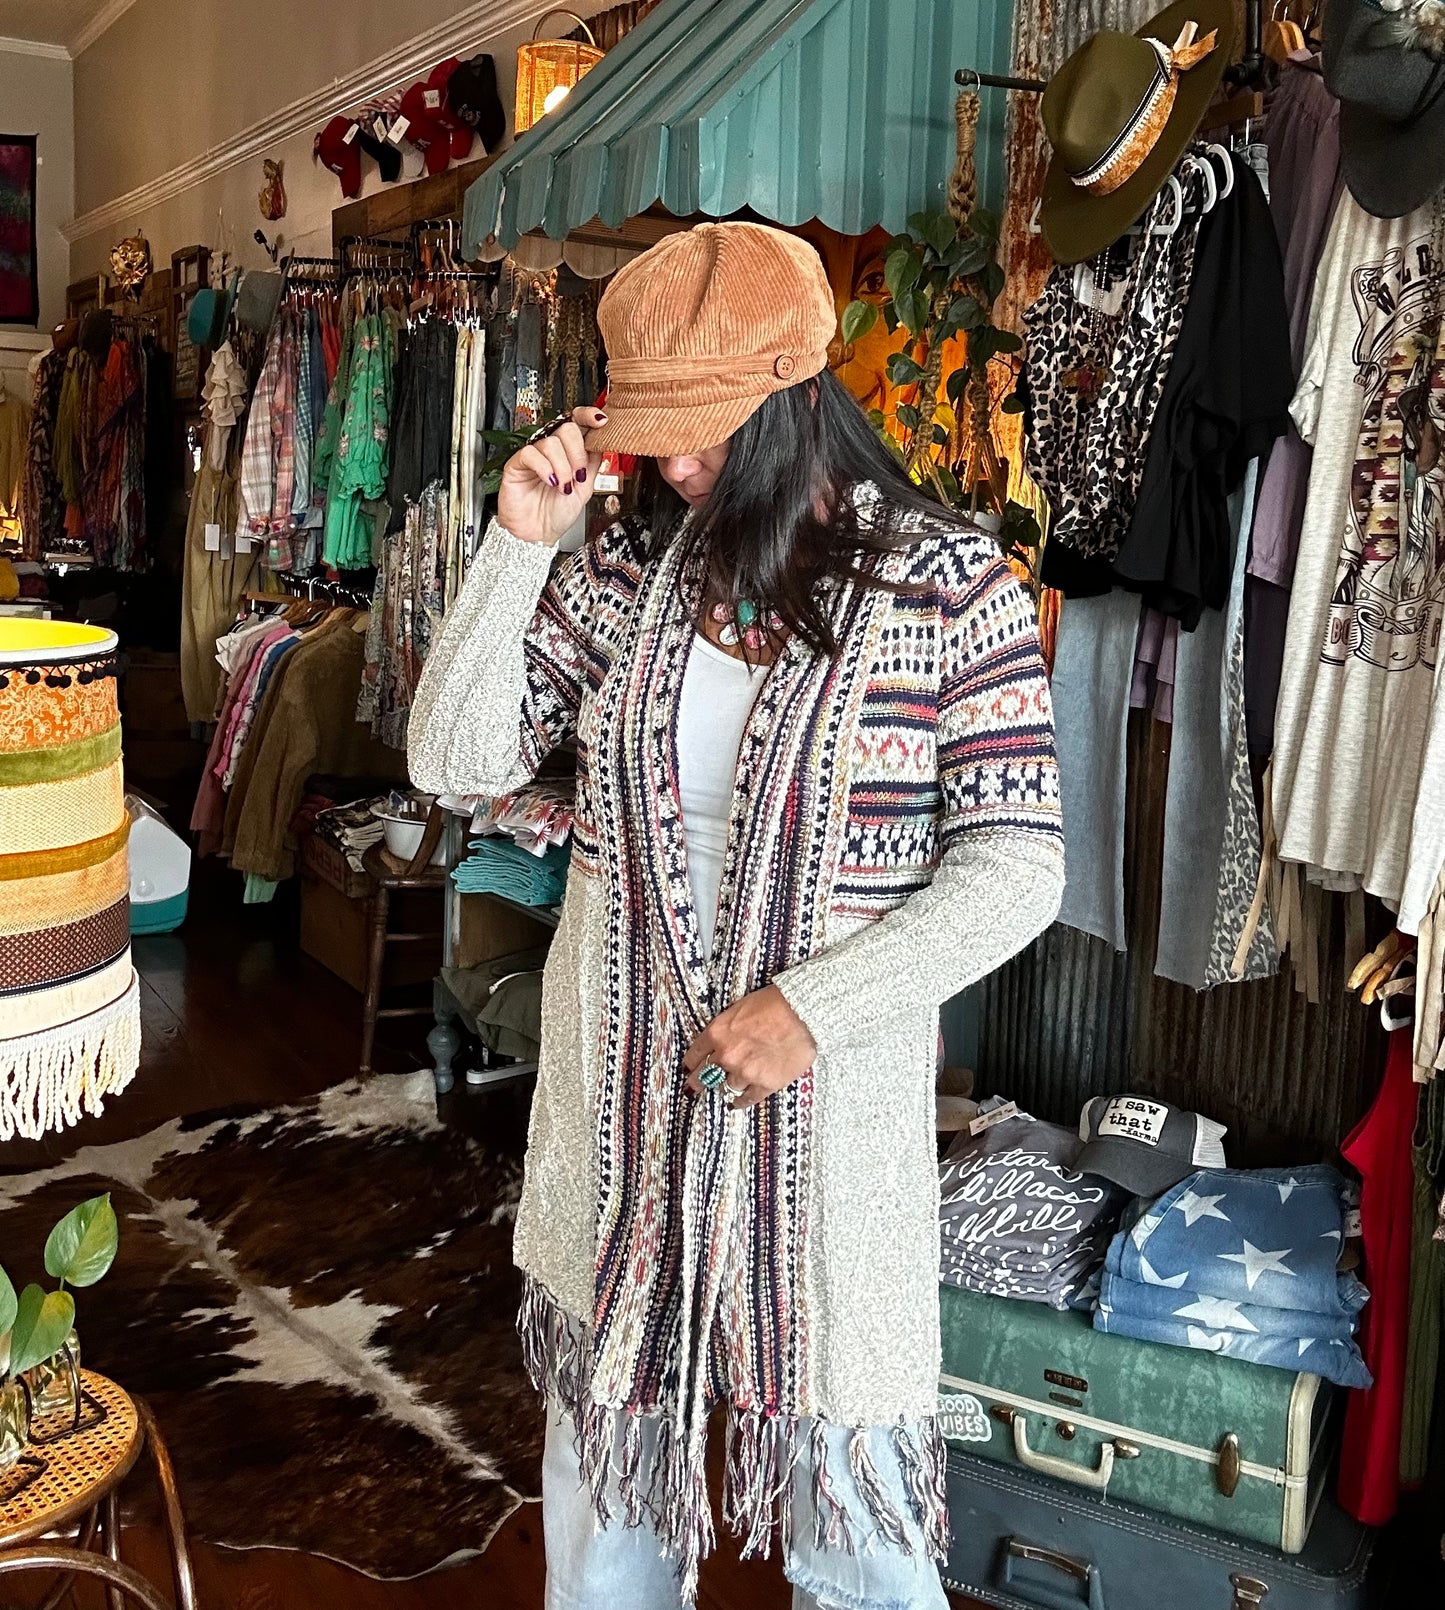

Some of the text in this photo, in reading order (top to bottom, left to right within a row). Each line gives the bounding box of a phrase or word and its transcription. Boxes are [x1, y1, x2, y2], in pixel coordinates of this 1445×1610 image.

[1111, 1098, 1161, 1115] I saw
[1109, 1113, 1152, 1131] that
[937, 1398, 977, 1414] GOOD
[937, 1414, 986, 1434] VIBES
